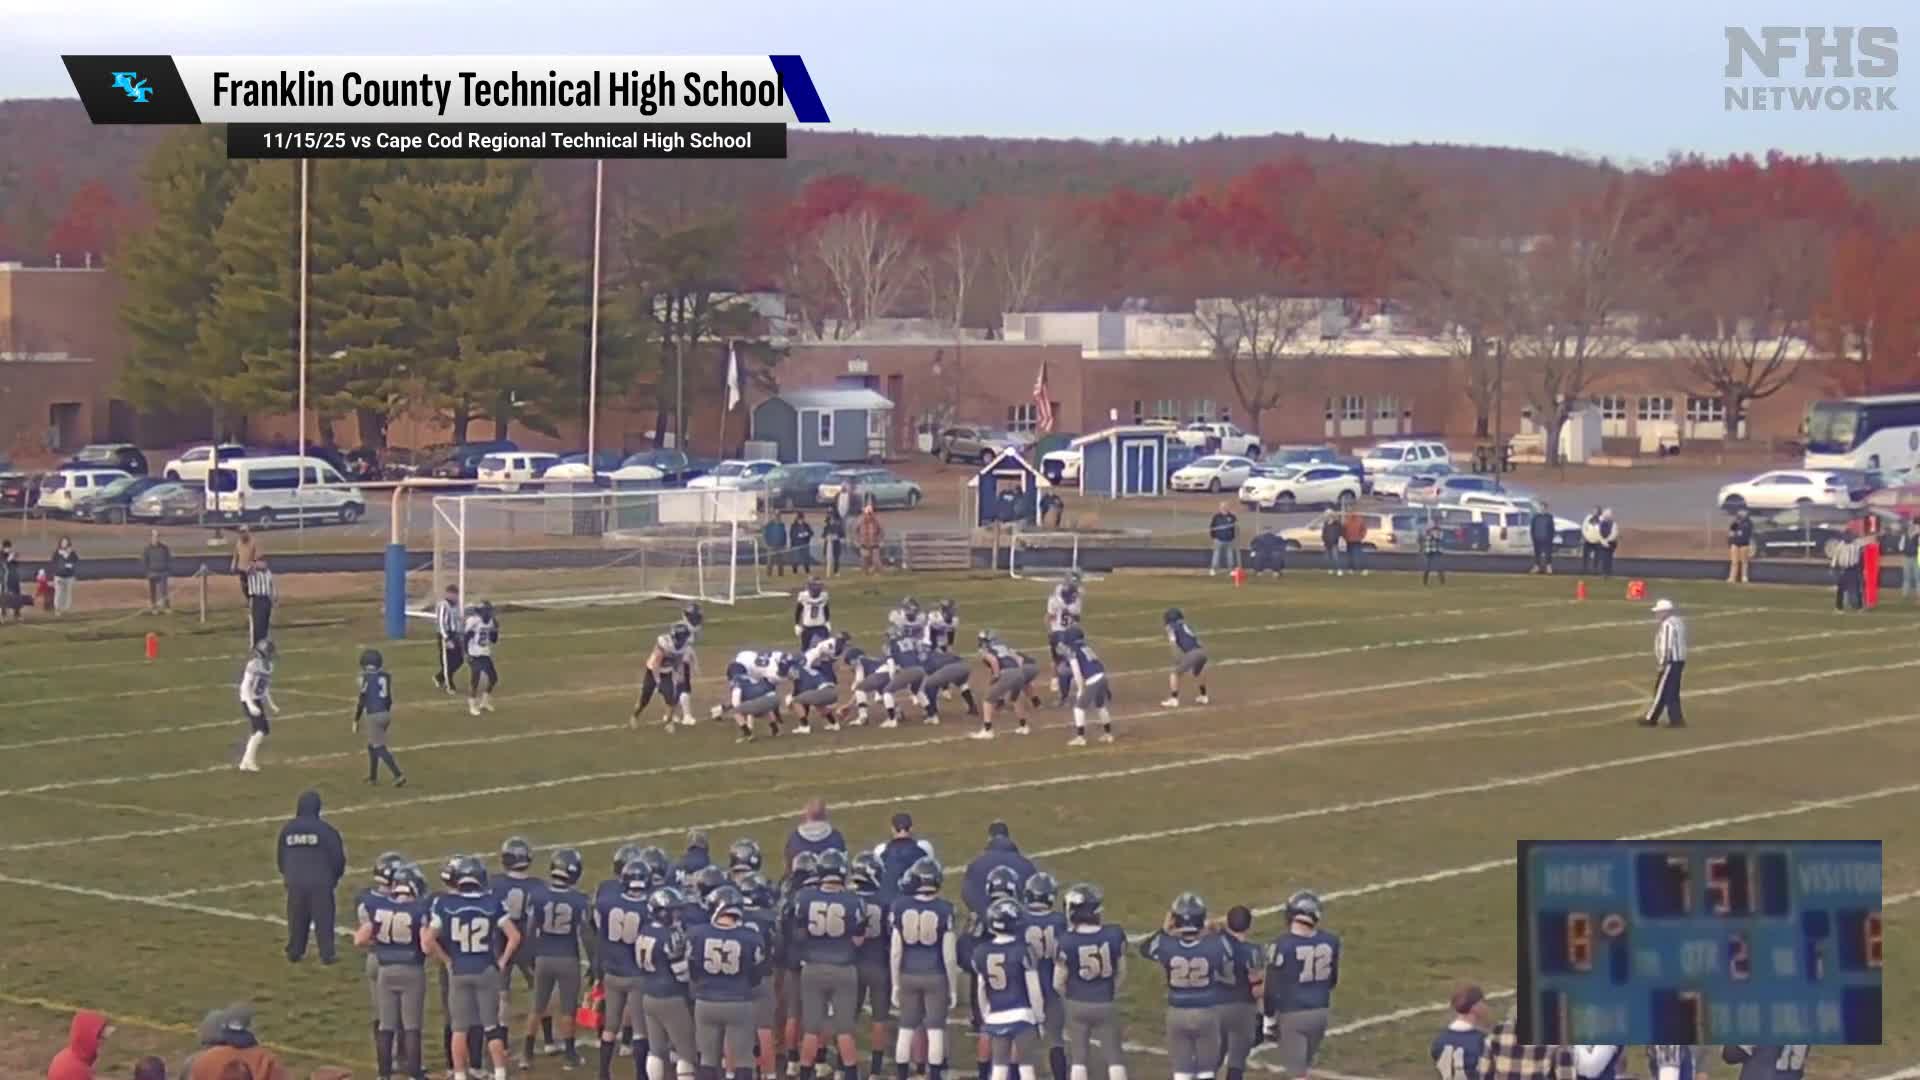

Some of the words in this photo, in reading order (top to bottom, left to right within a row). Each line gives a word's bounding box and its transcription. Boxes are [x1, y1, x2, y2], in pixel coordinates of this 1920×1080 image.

[450, 916, 490, 953] 42
[542, 901, 573, 935] 12
[807, 900, 846, 938] 56
[703, 937, 740, 975] 53
[986, 953, 1008, 991] 5
[1077, 941, 1113, 981] 51
[1169, 955, 1211, 988] 22
[1295, 943, 1334, 984] 72
